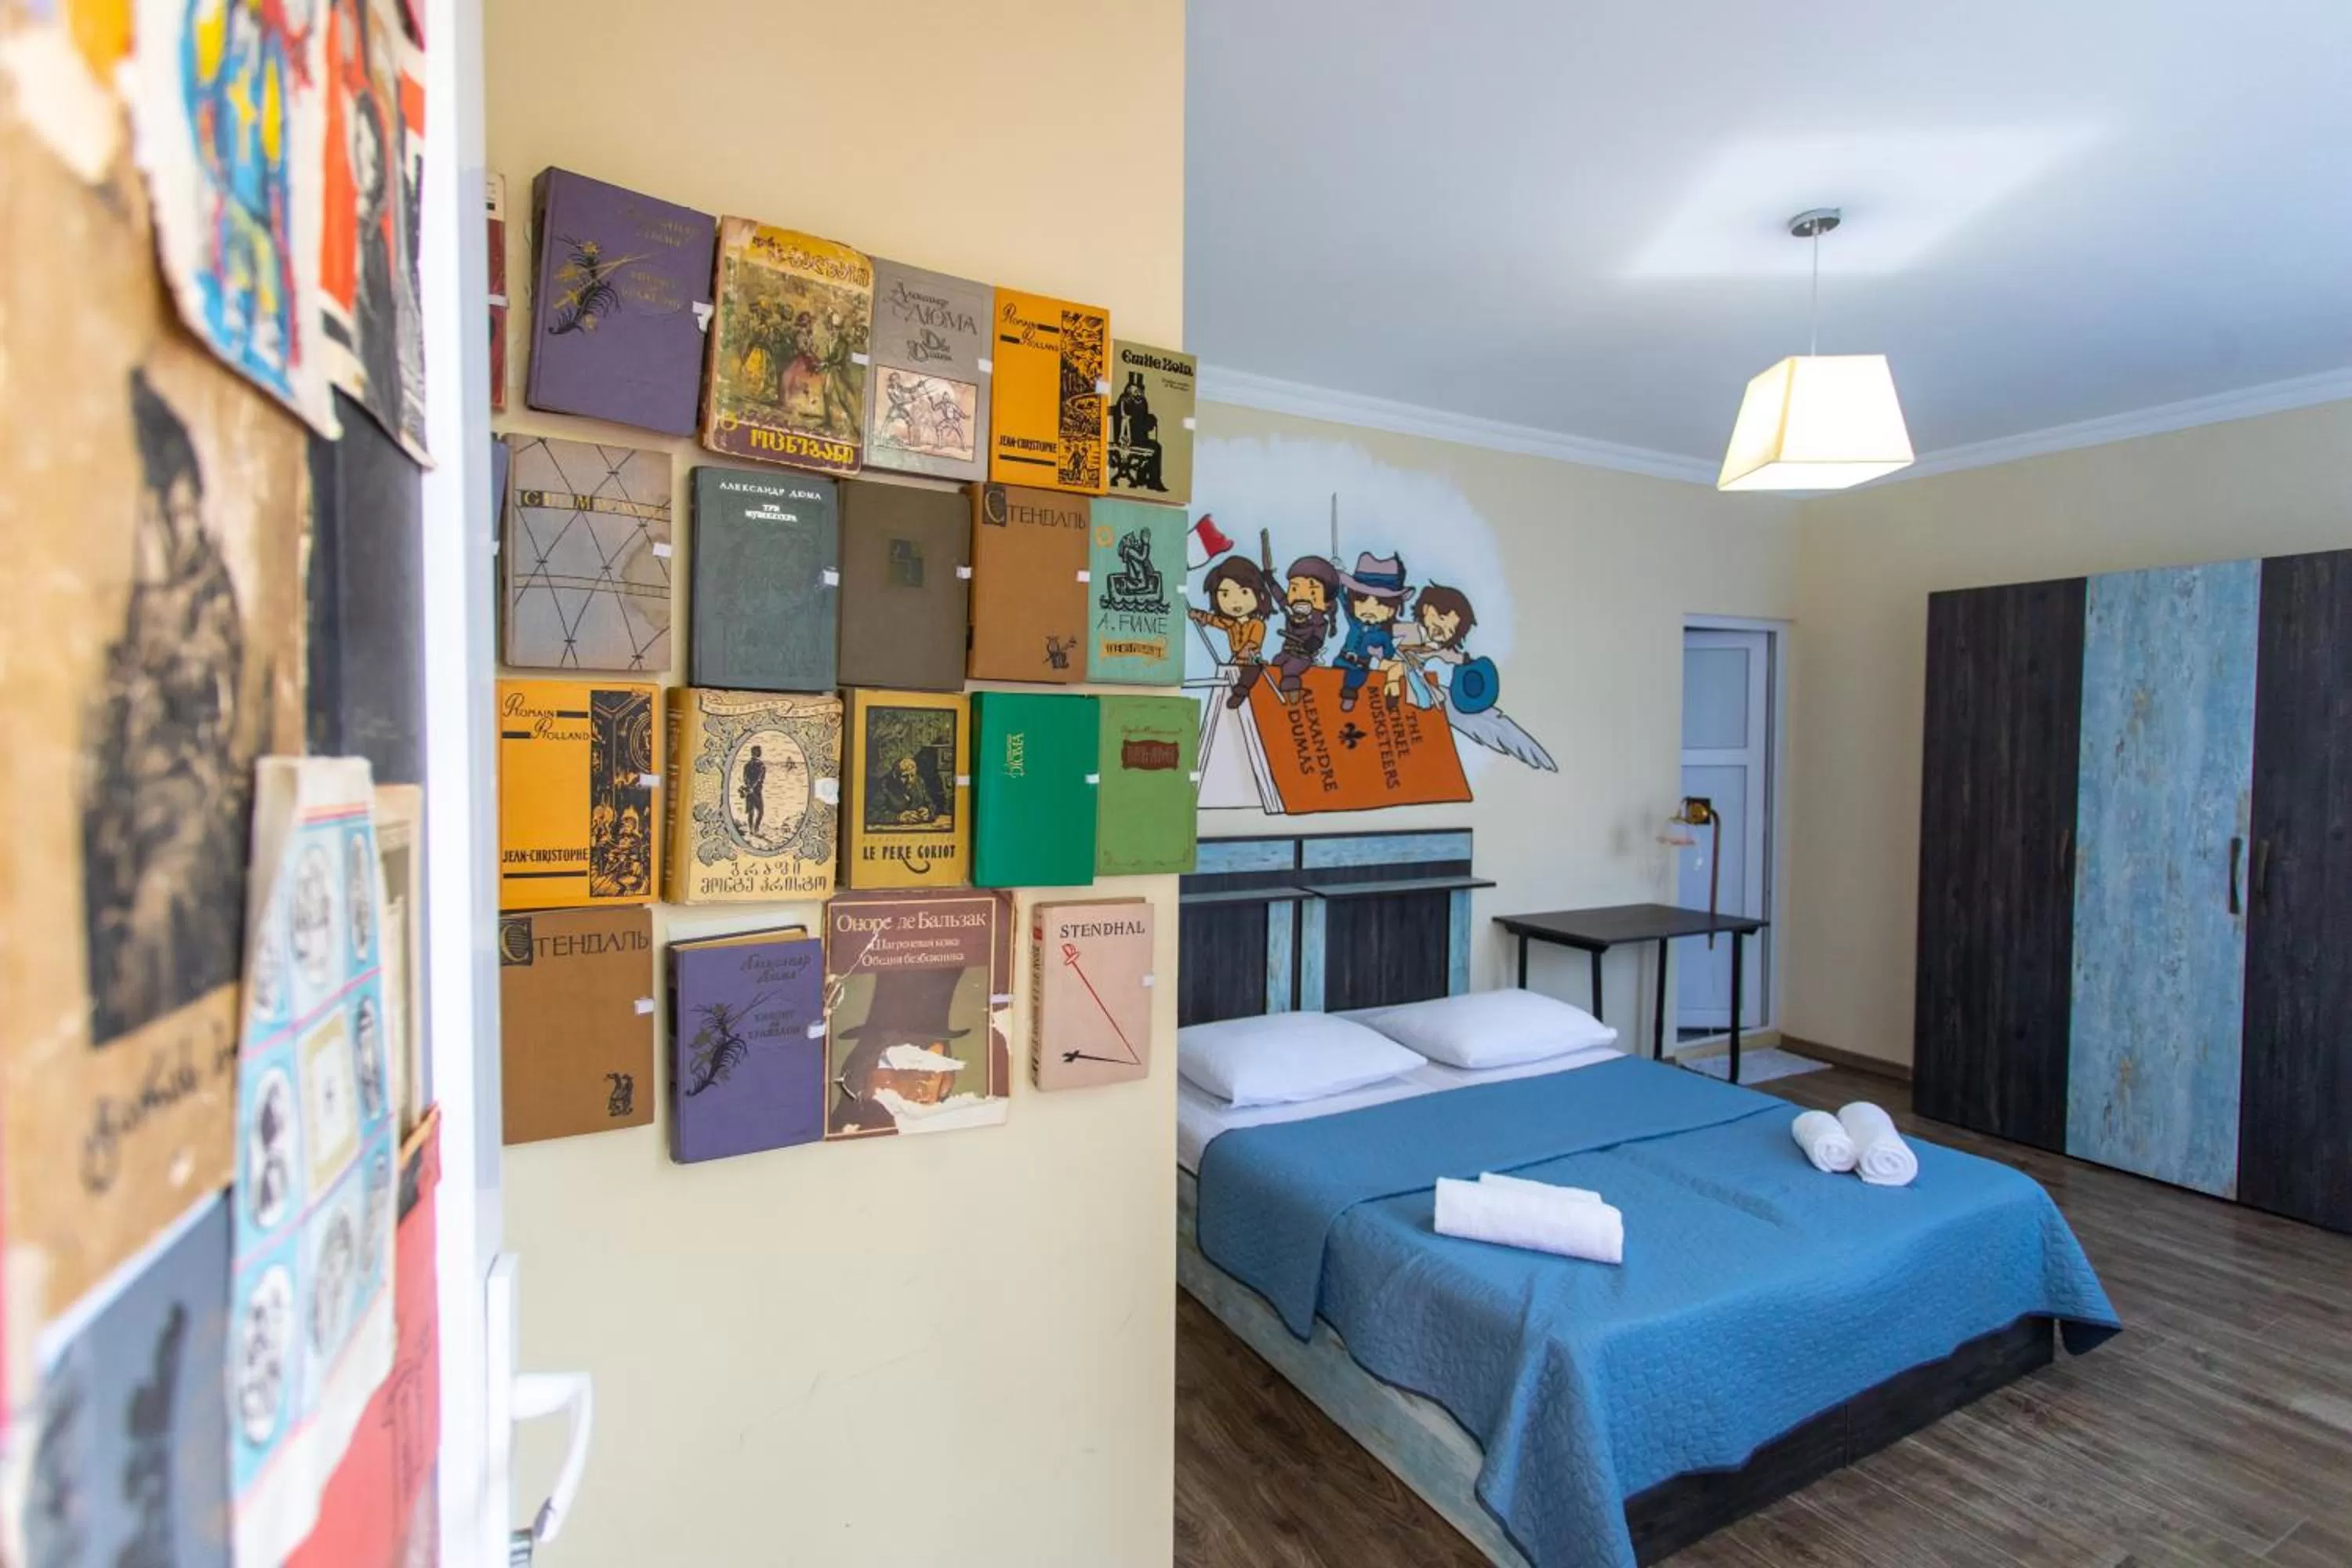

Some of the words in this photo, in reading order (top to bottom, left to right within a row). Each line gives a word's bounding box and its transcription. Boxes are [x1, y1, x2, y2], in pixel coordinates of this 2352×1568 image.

[719, 481, 785, 496] АЛЕКСАНДР
[984, 488, 1087, 530] СТЕНДАЛЬ
[1288, 709, 1315, 775] DUMAS
[1302, 688, 1338, 792] ALEXANDRE
[1367, 686, 1401, 790] MUSKETEERS
[1388, 707, 1410, 759] THREE
[1406, 711, 1423, 742] THE
[502, 848, 590, 863] JEAN-CHRISTOPHE
[863, 846, 876, 860] LE
[918, 911, 987, 930] Бальзак
[1060, 921, 1145, 938] STENDHAL
[501, 923, 649, 963] СТЕНДАЛЬ
